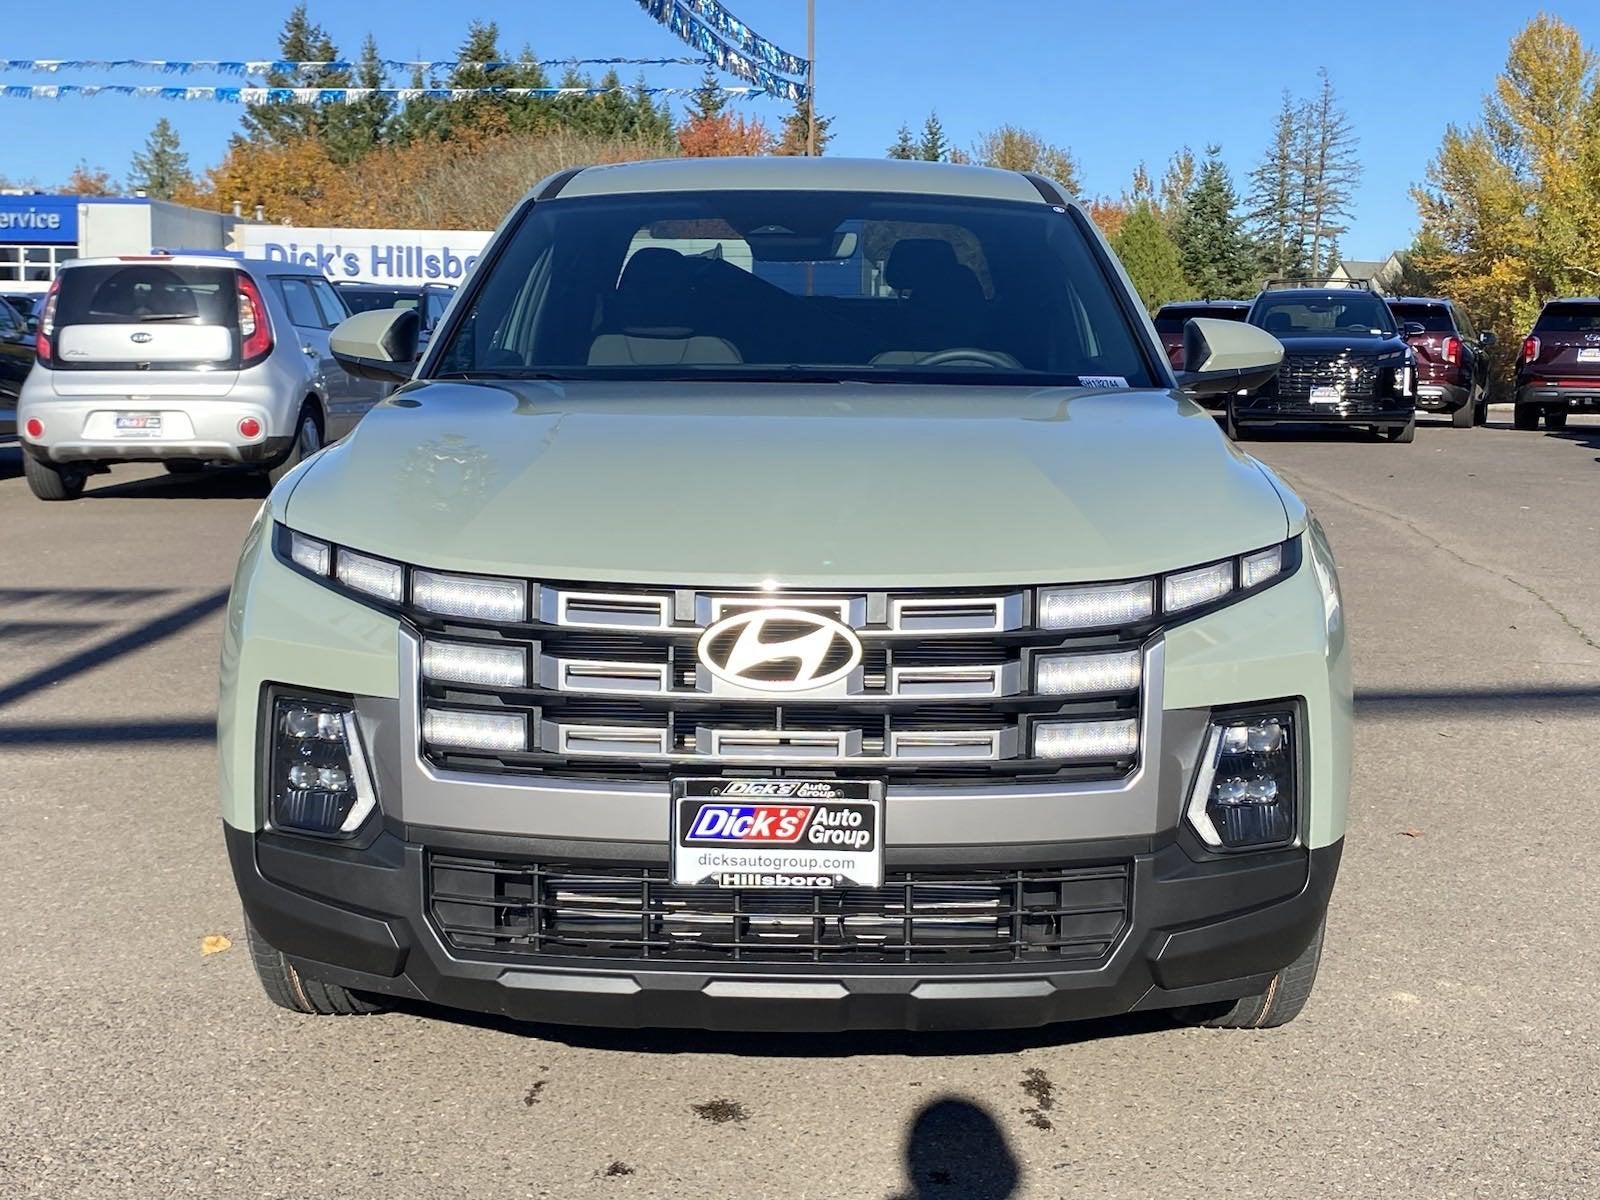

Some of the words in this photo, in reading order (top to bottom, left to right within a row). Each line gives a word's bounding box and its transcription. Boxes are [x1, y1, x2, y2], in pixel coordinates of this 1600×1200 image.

[797, 790, 836, 798] Group
[801, 783, 831, 791] Auto
[812, 807, 862, 827] Auto
[808, 828, 870, 848] Group
[698, 853, 855, 870] dicksautogroup.com
[722, 873, 832, 886] Hillsboro
